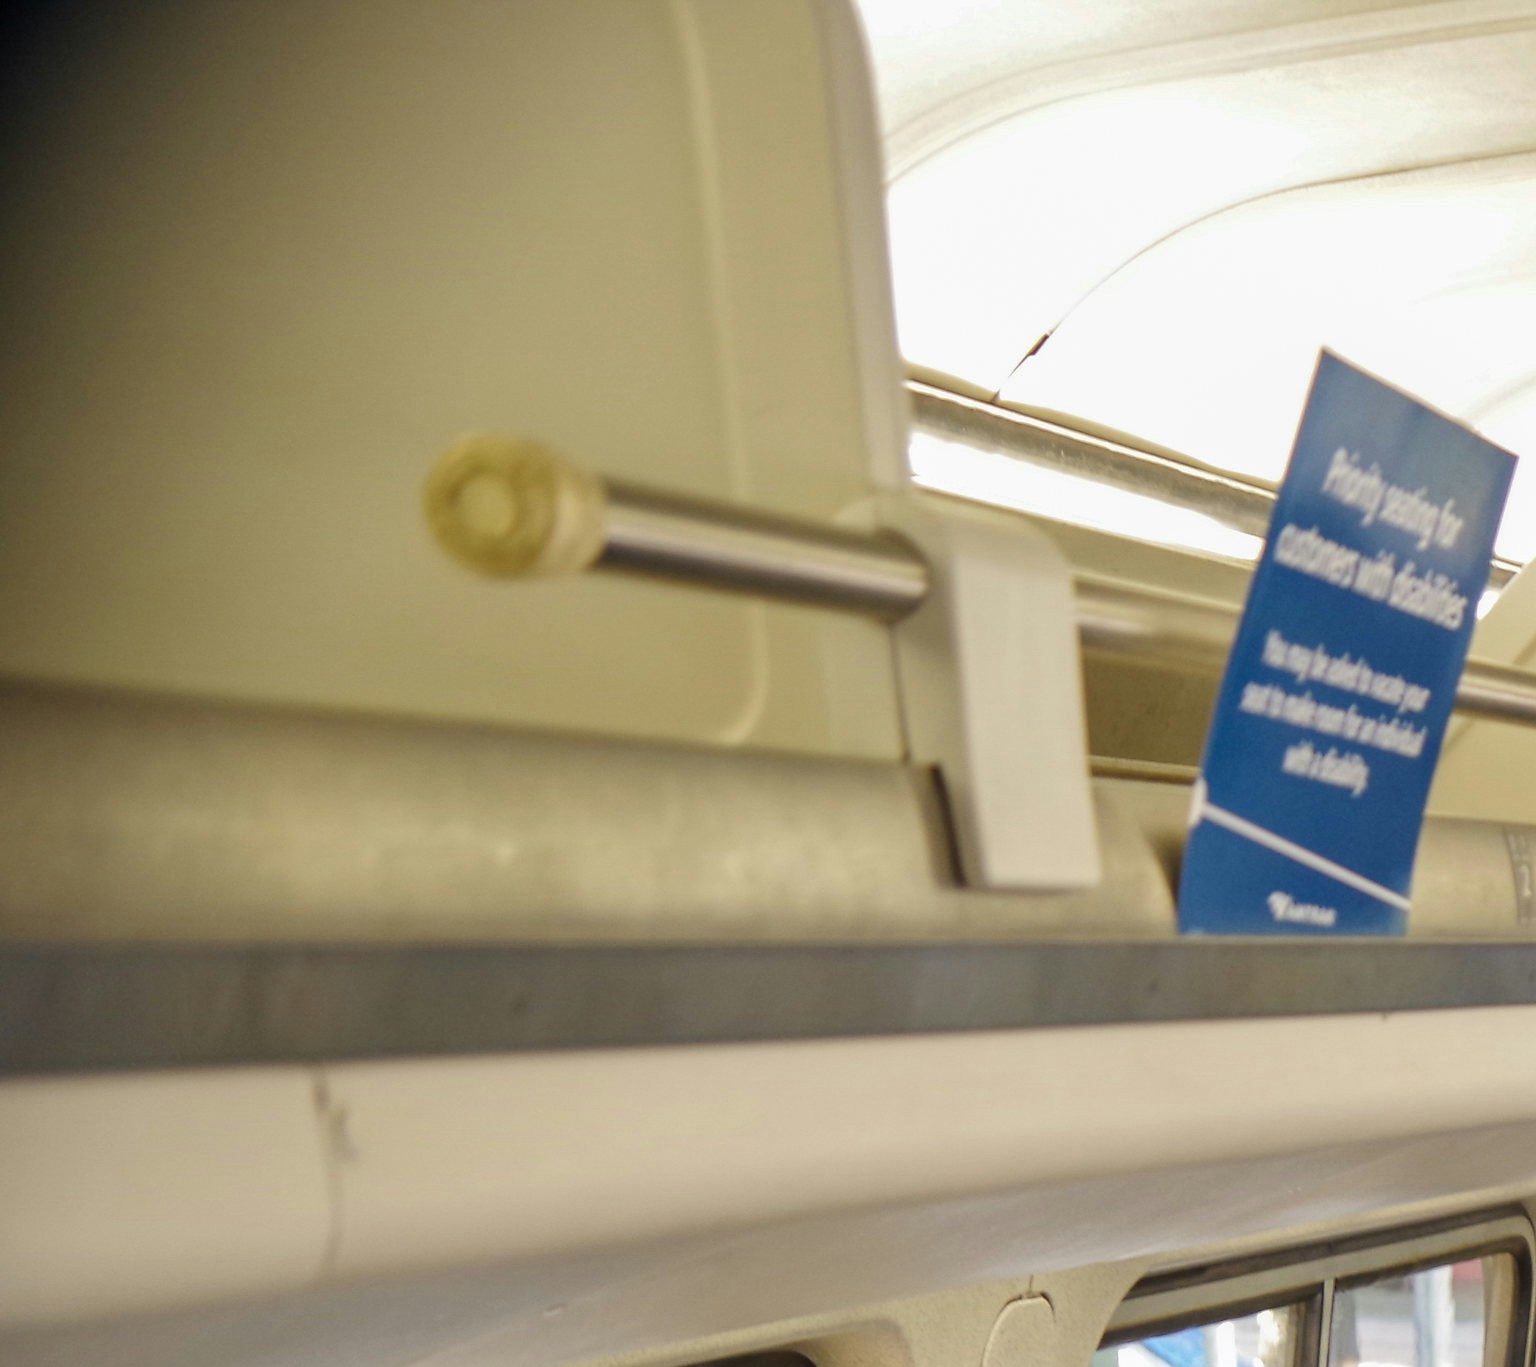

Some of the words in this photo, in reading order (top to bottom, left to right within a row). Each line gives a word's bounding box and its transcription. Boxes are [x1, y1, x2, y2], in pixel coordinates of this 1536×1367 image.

[1321, 446, 1387, 527] Priority
[1378, 484, 1440, 551] seating
[1435, 498, 1464, 548] for
[1274, 522, 1361, 588] customers
[1352, 548, 1396, 603] with
[1387, 560, 1468, 632] disabilities
[1286, 643, 1315, 684] may
[1309, 642, 1330, 683] be
[1356, 656, 1373, 695] to
[1397, 682, 1431, 714] your
[1281, 739, 1314, 777] with
